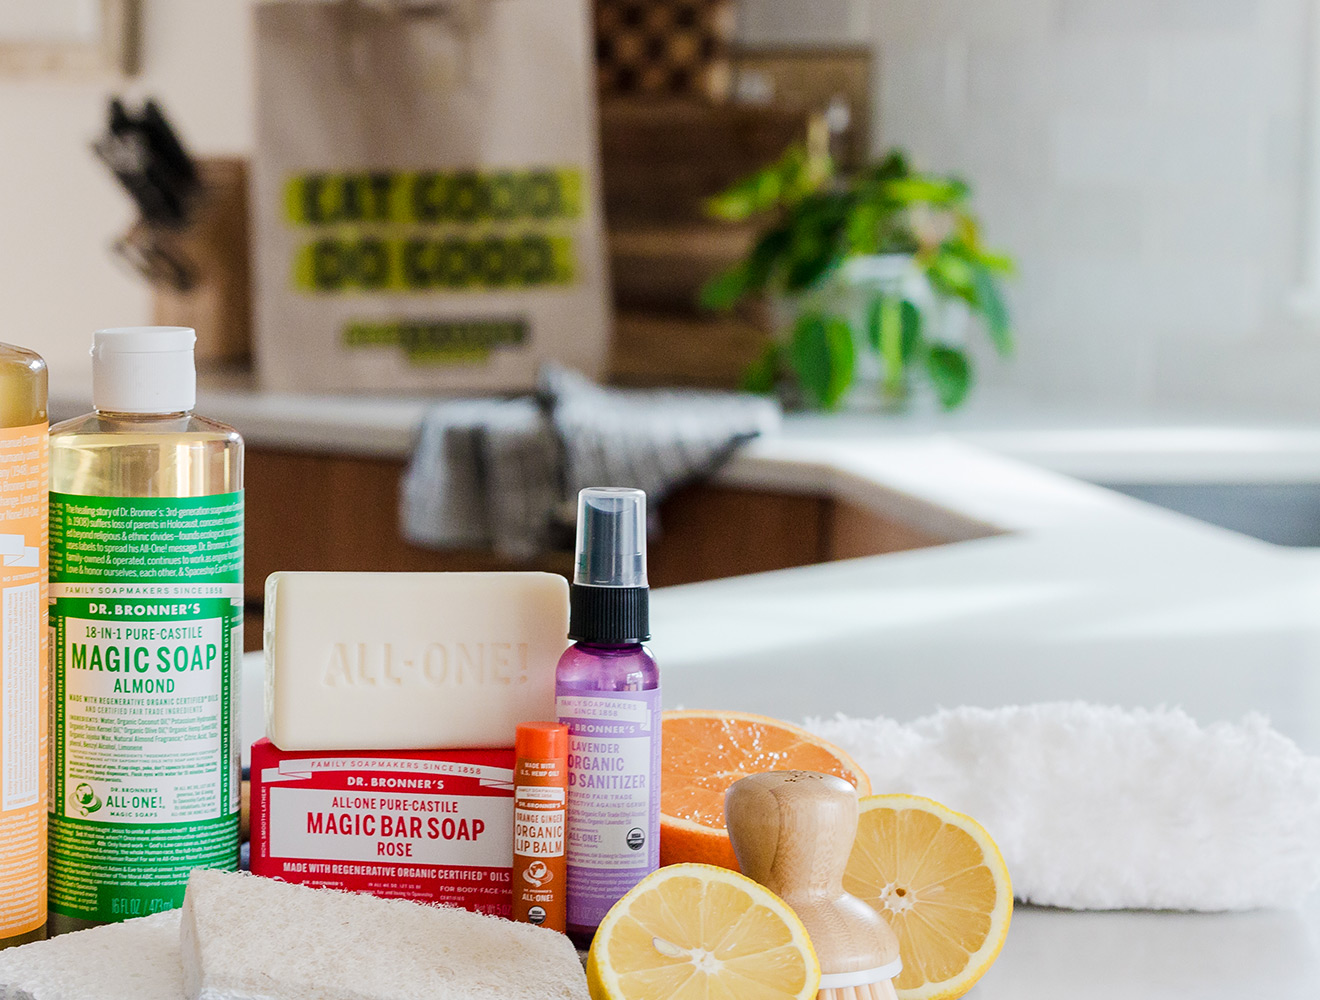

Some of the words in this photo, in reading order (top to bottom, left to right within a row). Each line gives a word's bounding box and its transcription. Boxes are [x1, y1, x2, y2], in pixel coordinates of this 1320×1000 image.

[89, 603, 112, 615] DR.
[115, 603, 200, 616] BRONNER'S
[86, 626, 122, 640] 18-IN-1
[126, 626, 202, 640] PURE-CASTILE
[72, 643, 149, 673] MAGIC
[157, 644, 216, 673] SOAP
[321, 642, 528, 687] ALL-ONE!
[114, 678, 175, 693] ALMOND
[575, 724, 635, 734] BRONNER'S
[571, 740, 620, 754] LAVENDER
[309, 758, 346, 767] FAMILY
[351, 760, 419, 769] SOAPMAKERS
[424, 763, 454, 772] SINCE
[458, 766, 481, 775] 1858
[567, 754, 625, 772] ORGANIC
[348, 776, 368, 786] DR.
[371, 778, 444, 789] BRONNER'S
[579, 773, 646, 789] SANITIZER
[106, 796, 165, 808] ALL-ONE!
[332, 797, 376, 809] ALL-ONE
[380, 798, 458, 813] PURE-CASTILE
[516, 814, 539, 824] ORANGE
[541, 814, 562, 823] GINGER
[307, 812, 376, 836] MAGIC
[381, 815, 422, 838] BAR
[427, 817, 485, 841] SOAP
[516, 825, 562, 838] ORGANIC
[569, 832, 601, 843] ALL-ONE!
[378, 842, 413, 857] ROSE
[516, 840, 530, 853] LIP
[533, 840, 562, 854] BALM
[284, 862, 307, 873] MADE
[309, 863, 331, 873] WITH
[332, 864, 396, 877] REGENERATIVE
[398, 867, 437, 879] ORGANIC
[490, 872, 509, 882] OILS
[522, 894, 554, 902] ALL-ONE!
